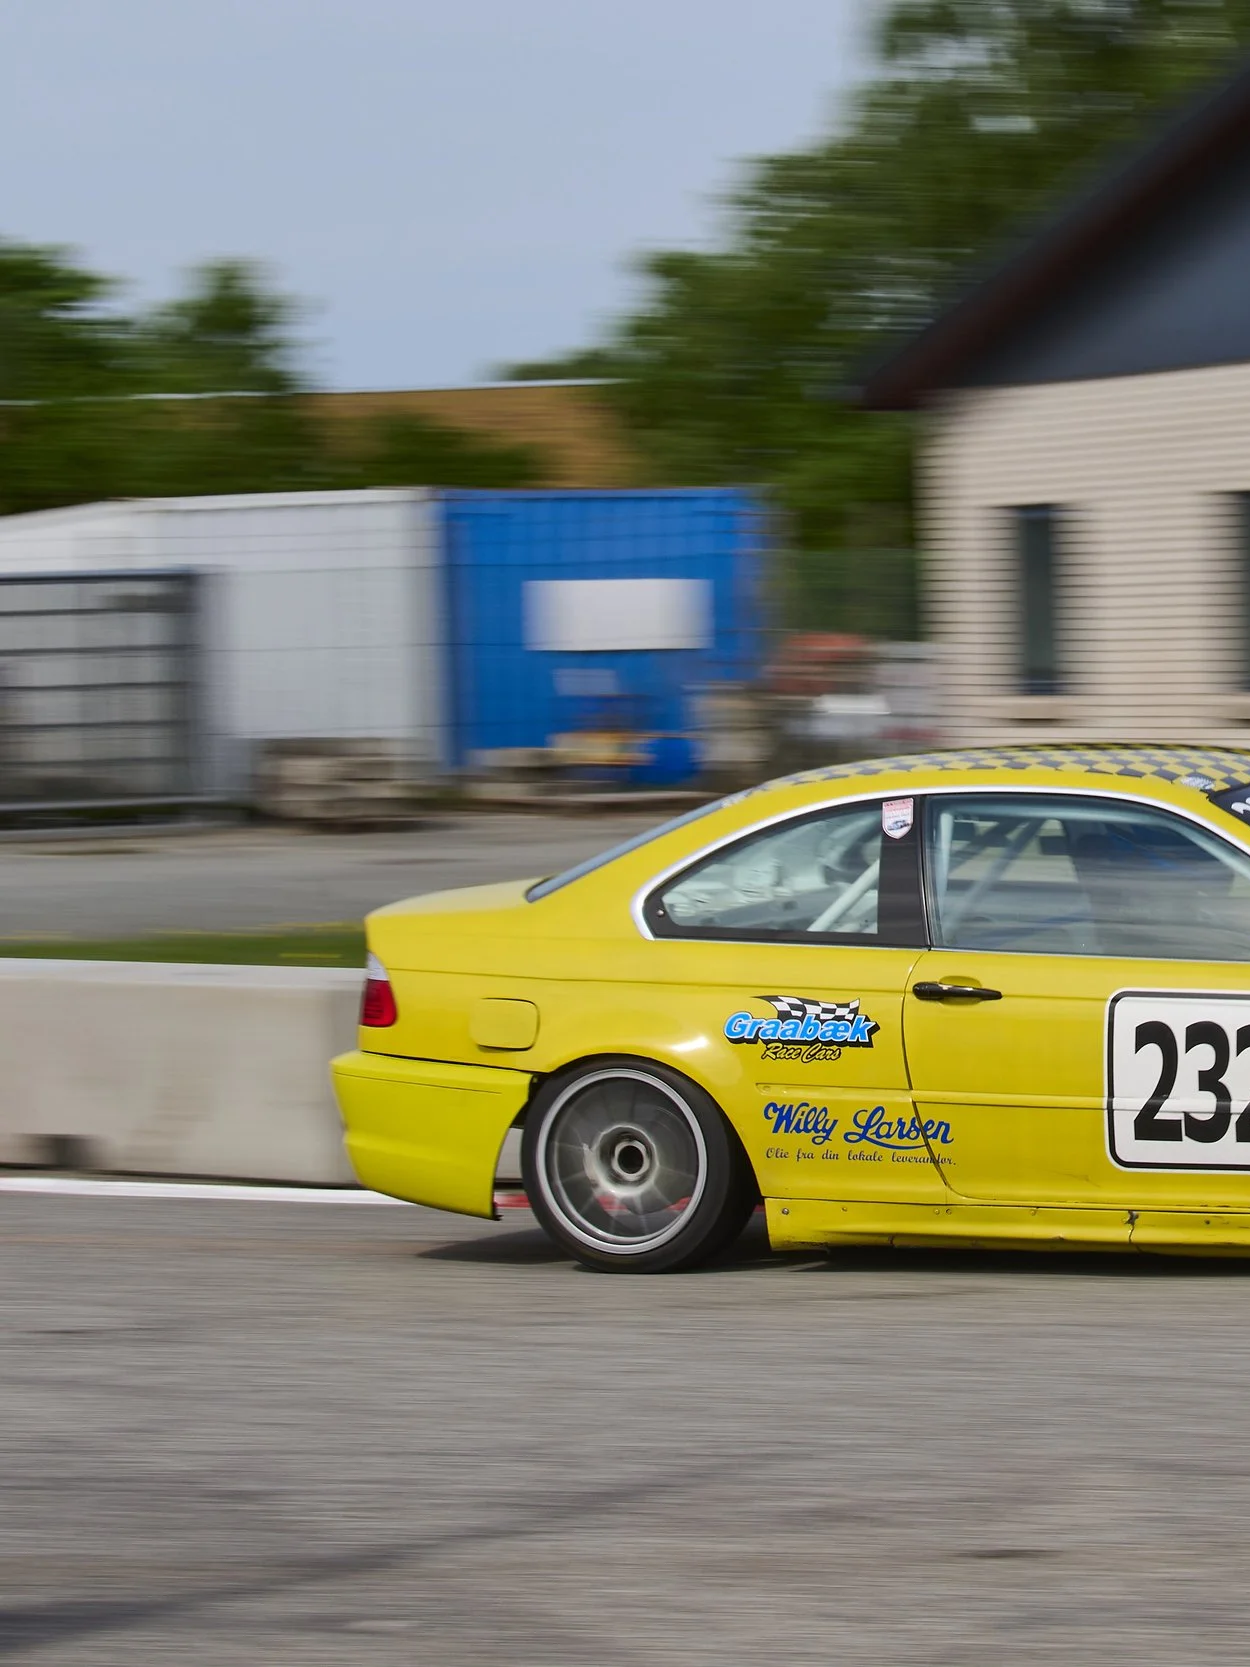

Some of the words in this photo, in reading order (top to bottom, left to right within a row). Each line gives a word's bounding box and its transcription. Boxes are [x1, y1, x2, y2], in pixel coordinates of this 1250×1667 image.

[724, 1011, 879, 1046] Graabæk
[761, 1043, 800, 1061] Race
[801, 1043, 842, 1063] Cars
[764, 1102, 838, 1145] Willy
[844, 1105, 954, 1149] Larsen
[766, 1147, 789, 1159] Olie
[796, 1148, 815, 1162] fra
[821, 1149, 839, 1160] din
[848, 1150, 883, 1162] lokale
